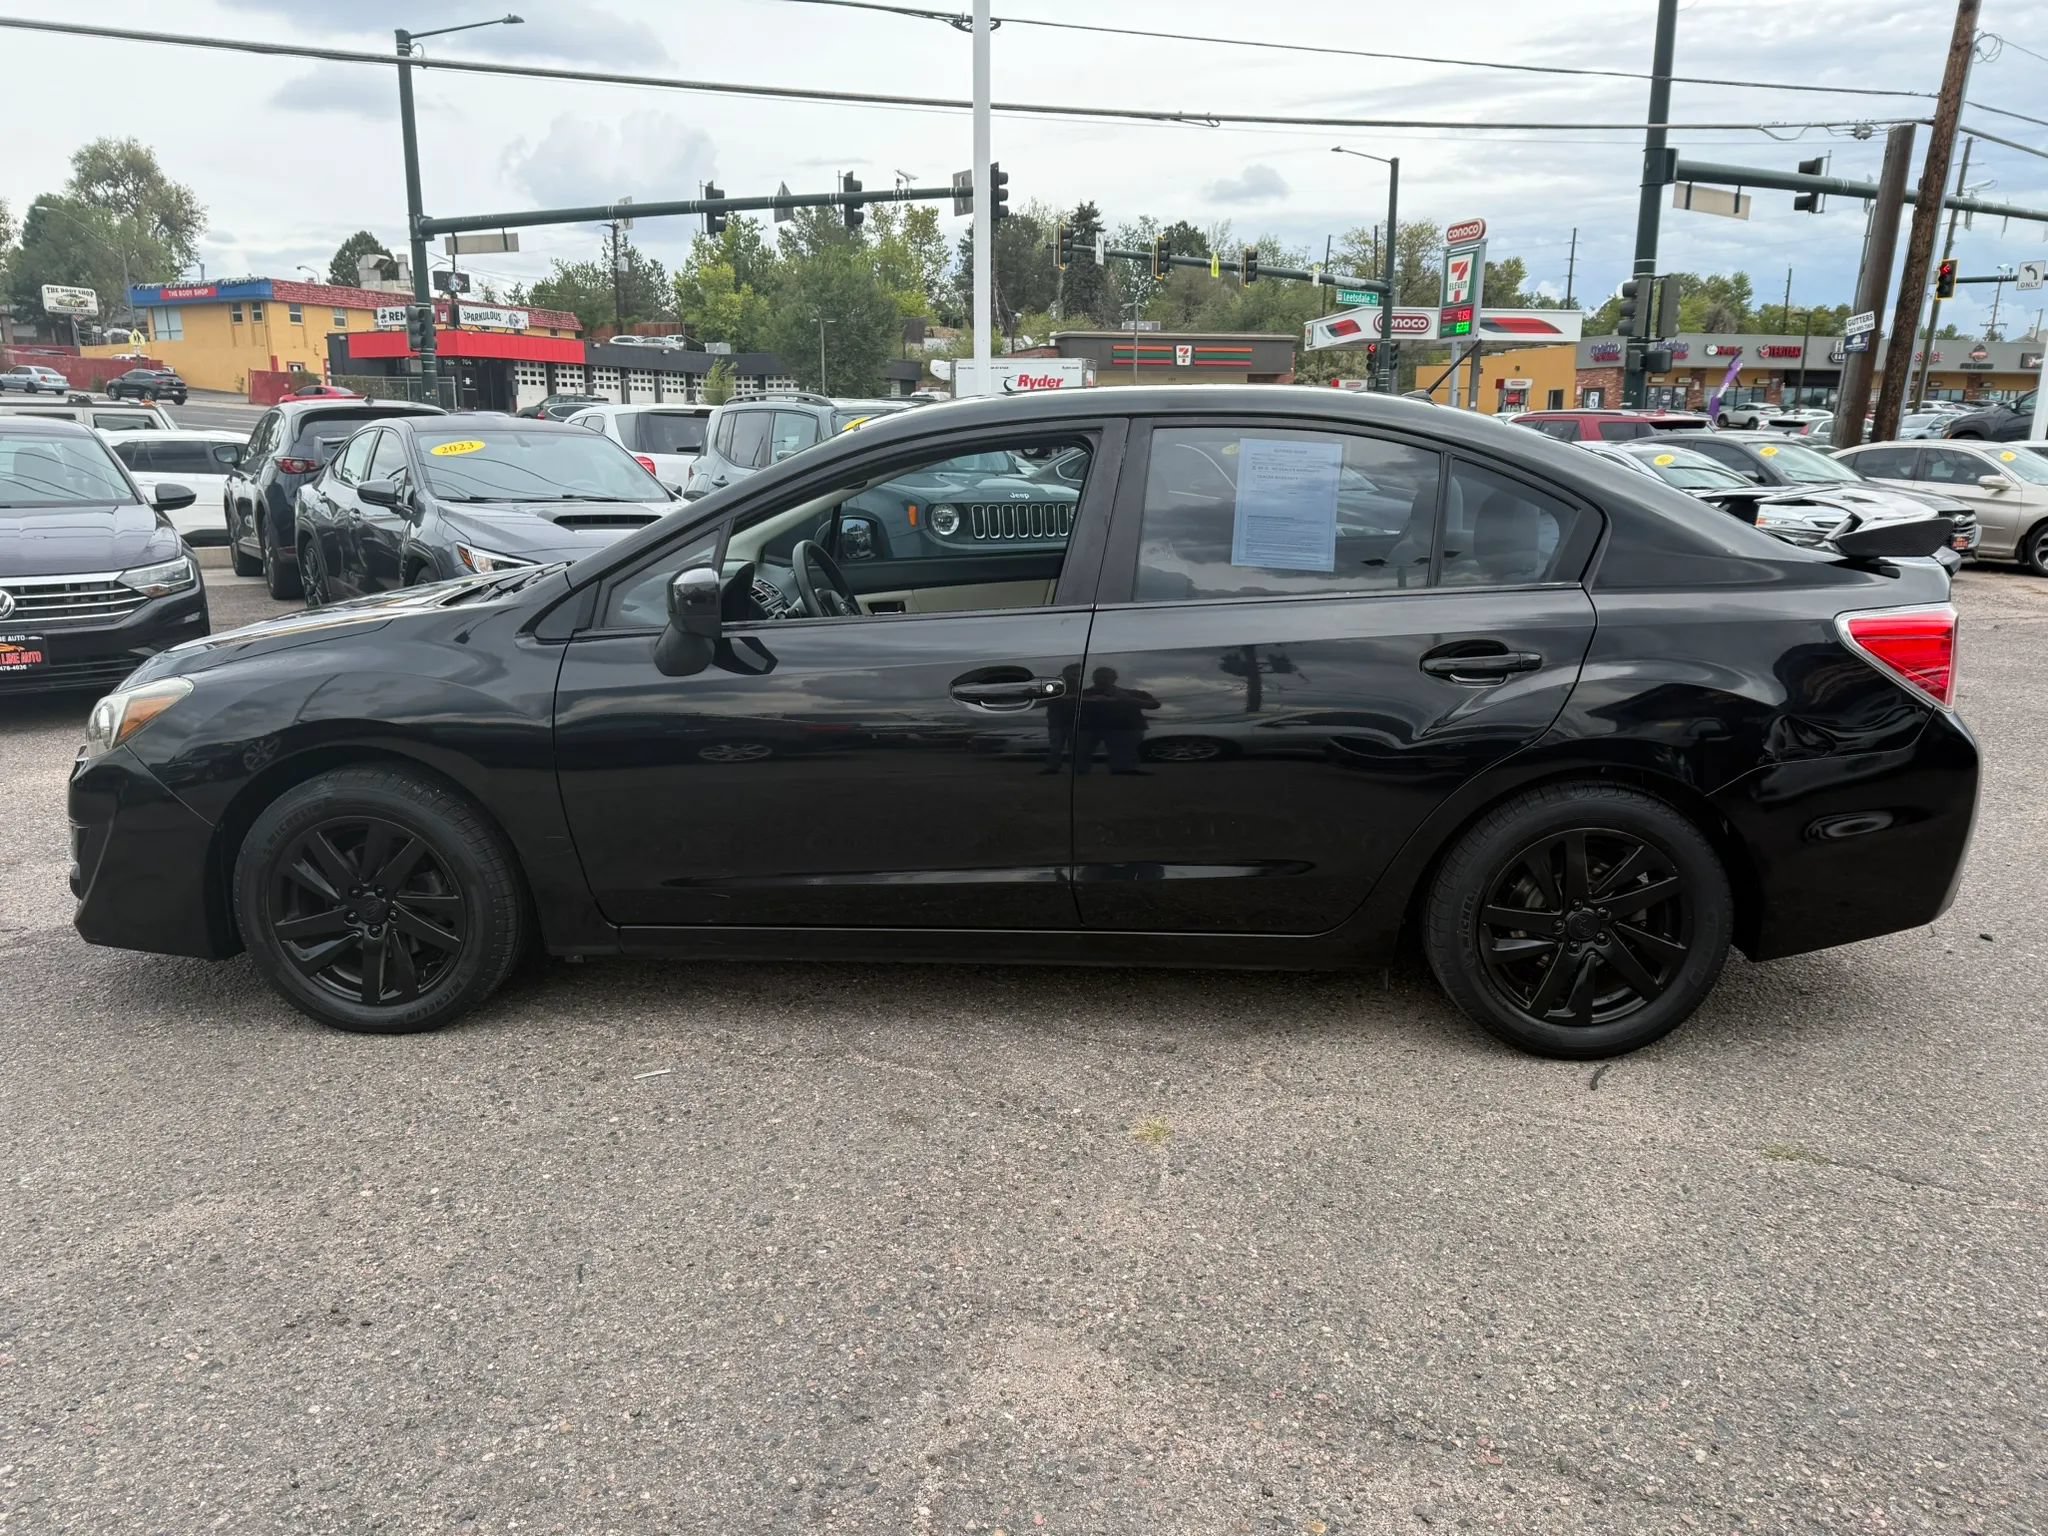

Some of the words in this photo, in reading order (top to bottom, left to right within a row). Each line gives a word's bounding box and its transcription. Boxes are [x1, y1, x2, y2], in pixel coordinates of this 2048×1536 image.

[1448, 224, 1479, 239] conoco
[178, 289, 193, 297] BODY
[194, 288, 209, 297] SHOP
[463, 311, 502, 322] SPARKULOUS
[1848, 313, 1873, 327] GUTTERS
[1017, 374, 1063, 390] Ryder
[440, 442, 474, 454] 2023
[1009, 492, 1030, 500] Jeep
